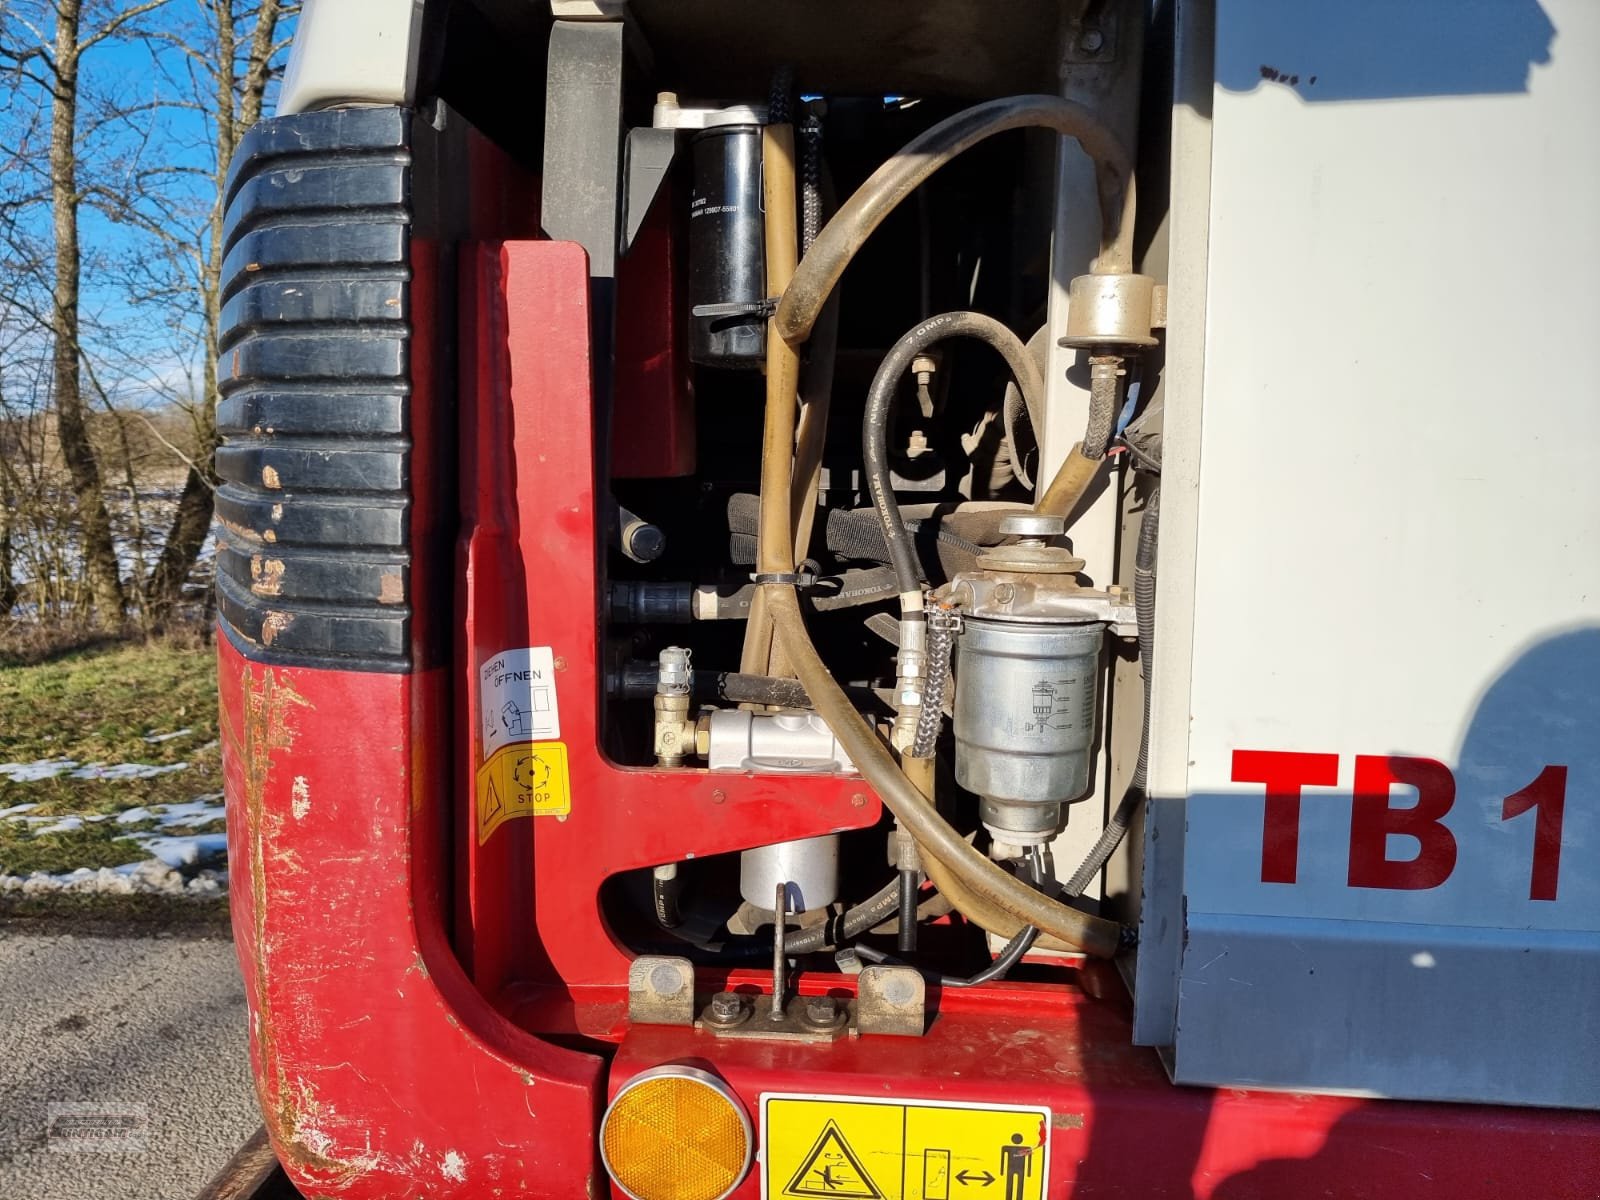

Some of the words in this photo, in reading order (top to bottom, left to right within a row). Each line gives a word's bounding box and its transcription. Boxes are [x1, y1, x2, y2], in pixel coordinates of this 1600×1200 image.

[872, 471, 893, 530] YOKOHAMA
[484, 659, 505, 680] ZIEHEN
[494, 669, 542, 688] ÖFFNEN
[518, 792, 551, 804] STOP
[1231, 749, 1457, 891] TB
[1502, 765, 1568, 901] 1
